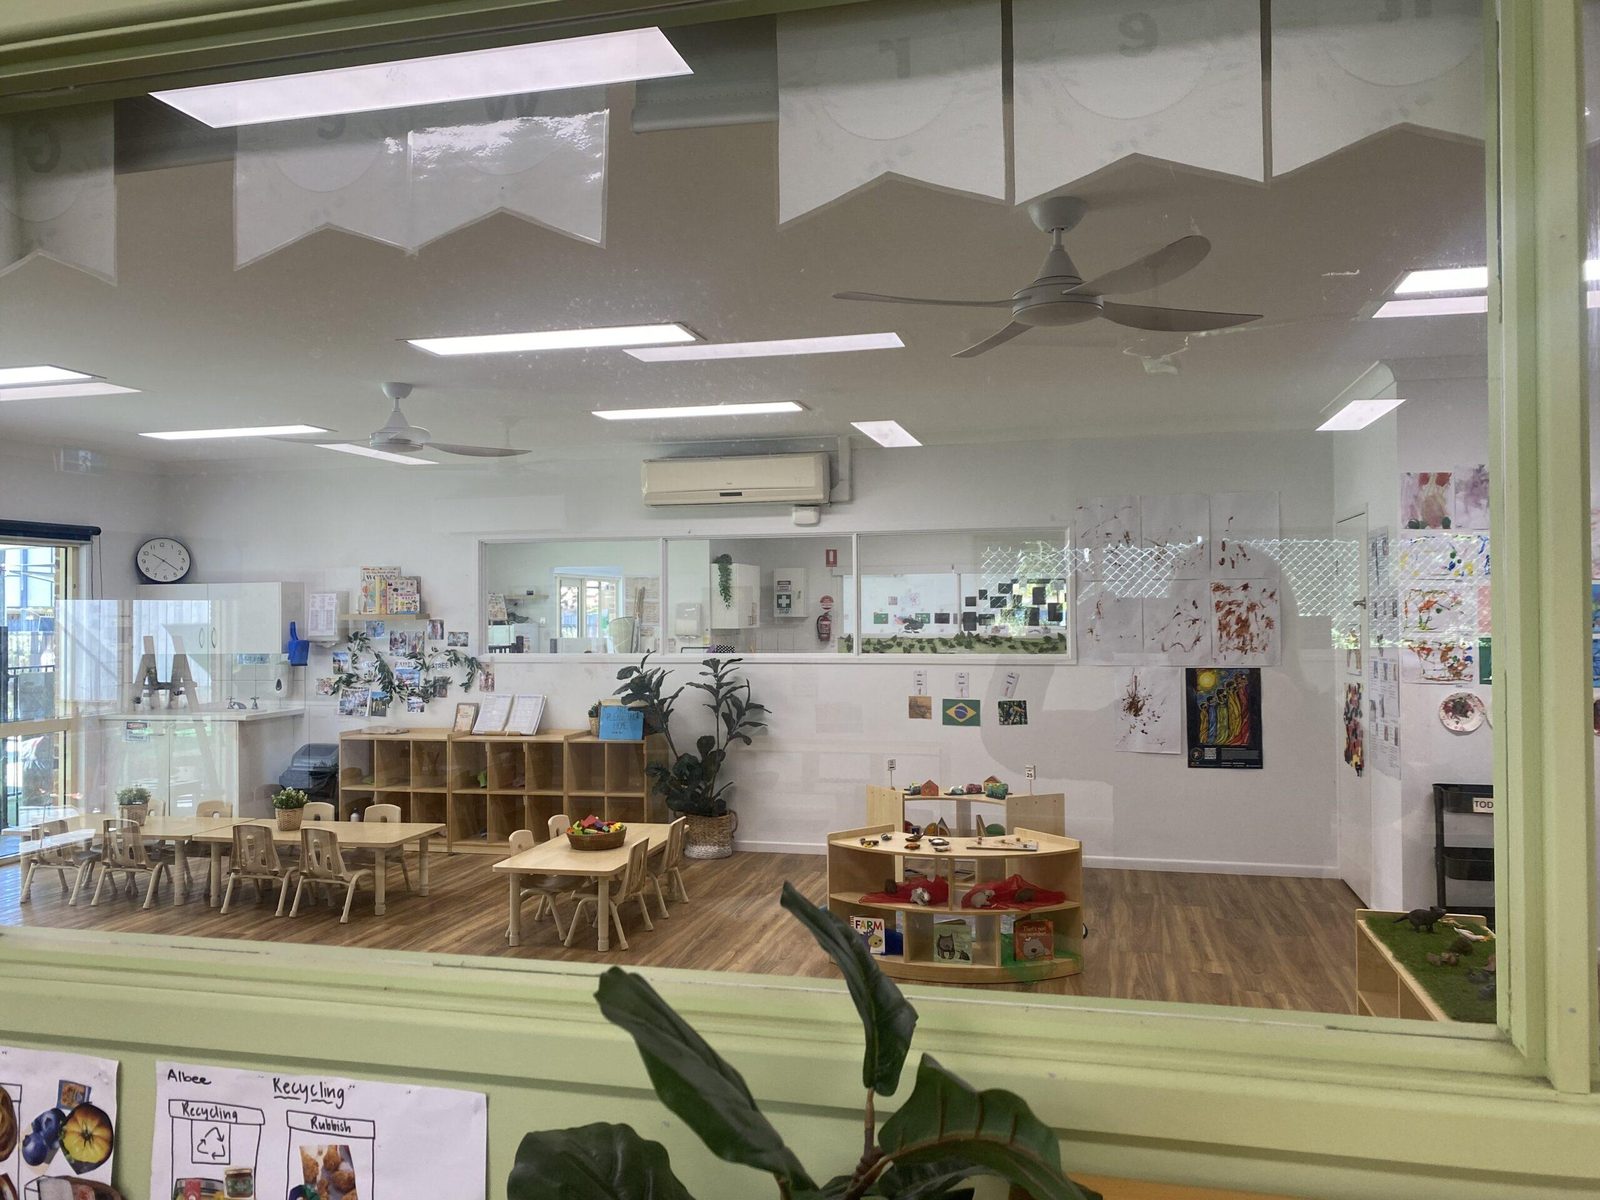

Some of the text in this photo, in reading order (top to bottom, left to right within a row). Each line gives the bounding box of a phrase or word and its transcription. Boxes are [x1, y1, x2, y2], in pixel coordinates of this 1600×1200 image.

[855, 919, 883, 931] FARM
[167, 1069, 212, 1085] Albee
[181, 1100, 238, 1124] Recycling
[310, 1115, 352, 1133] Rubbish
